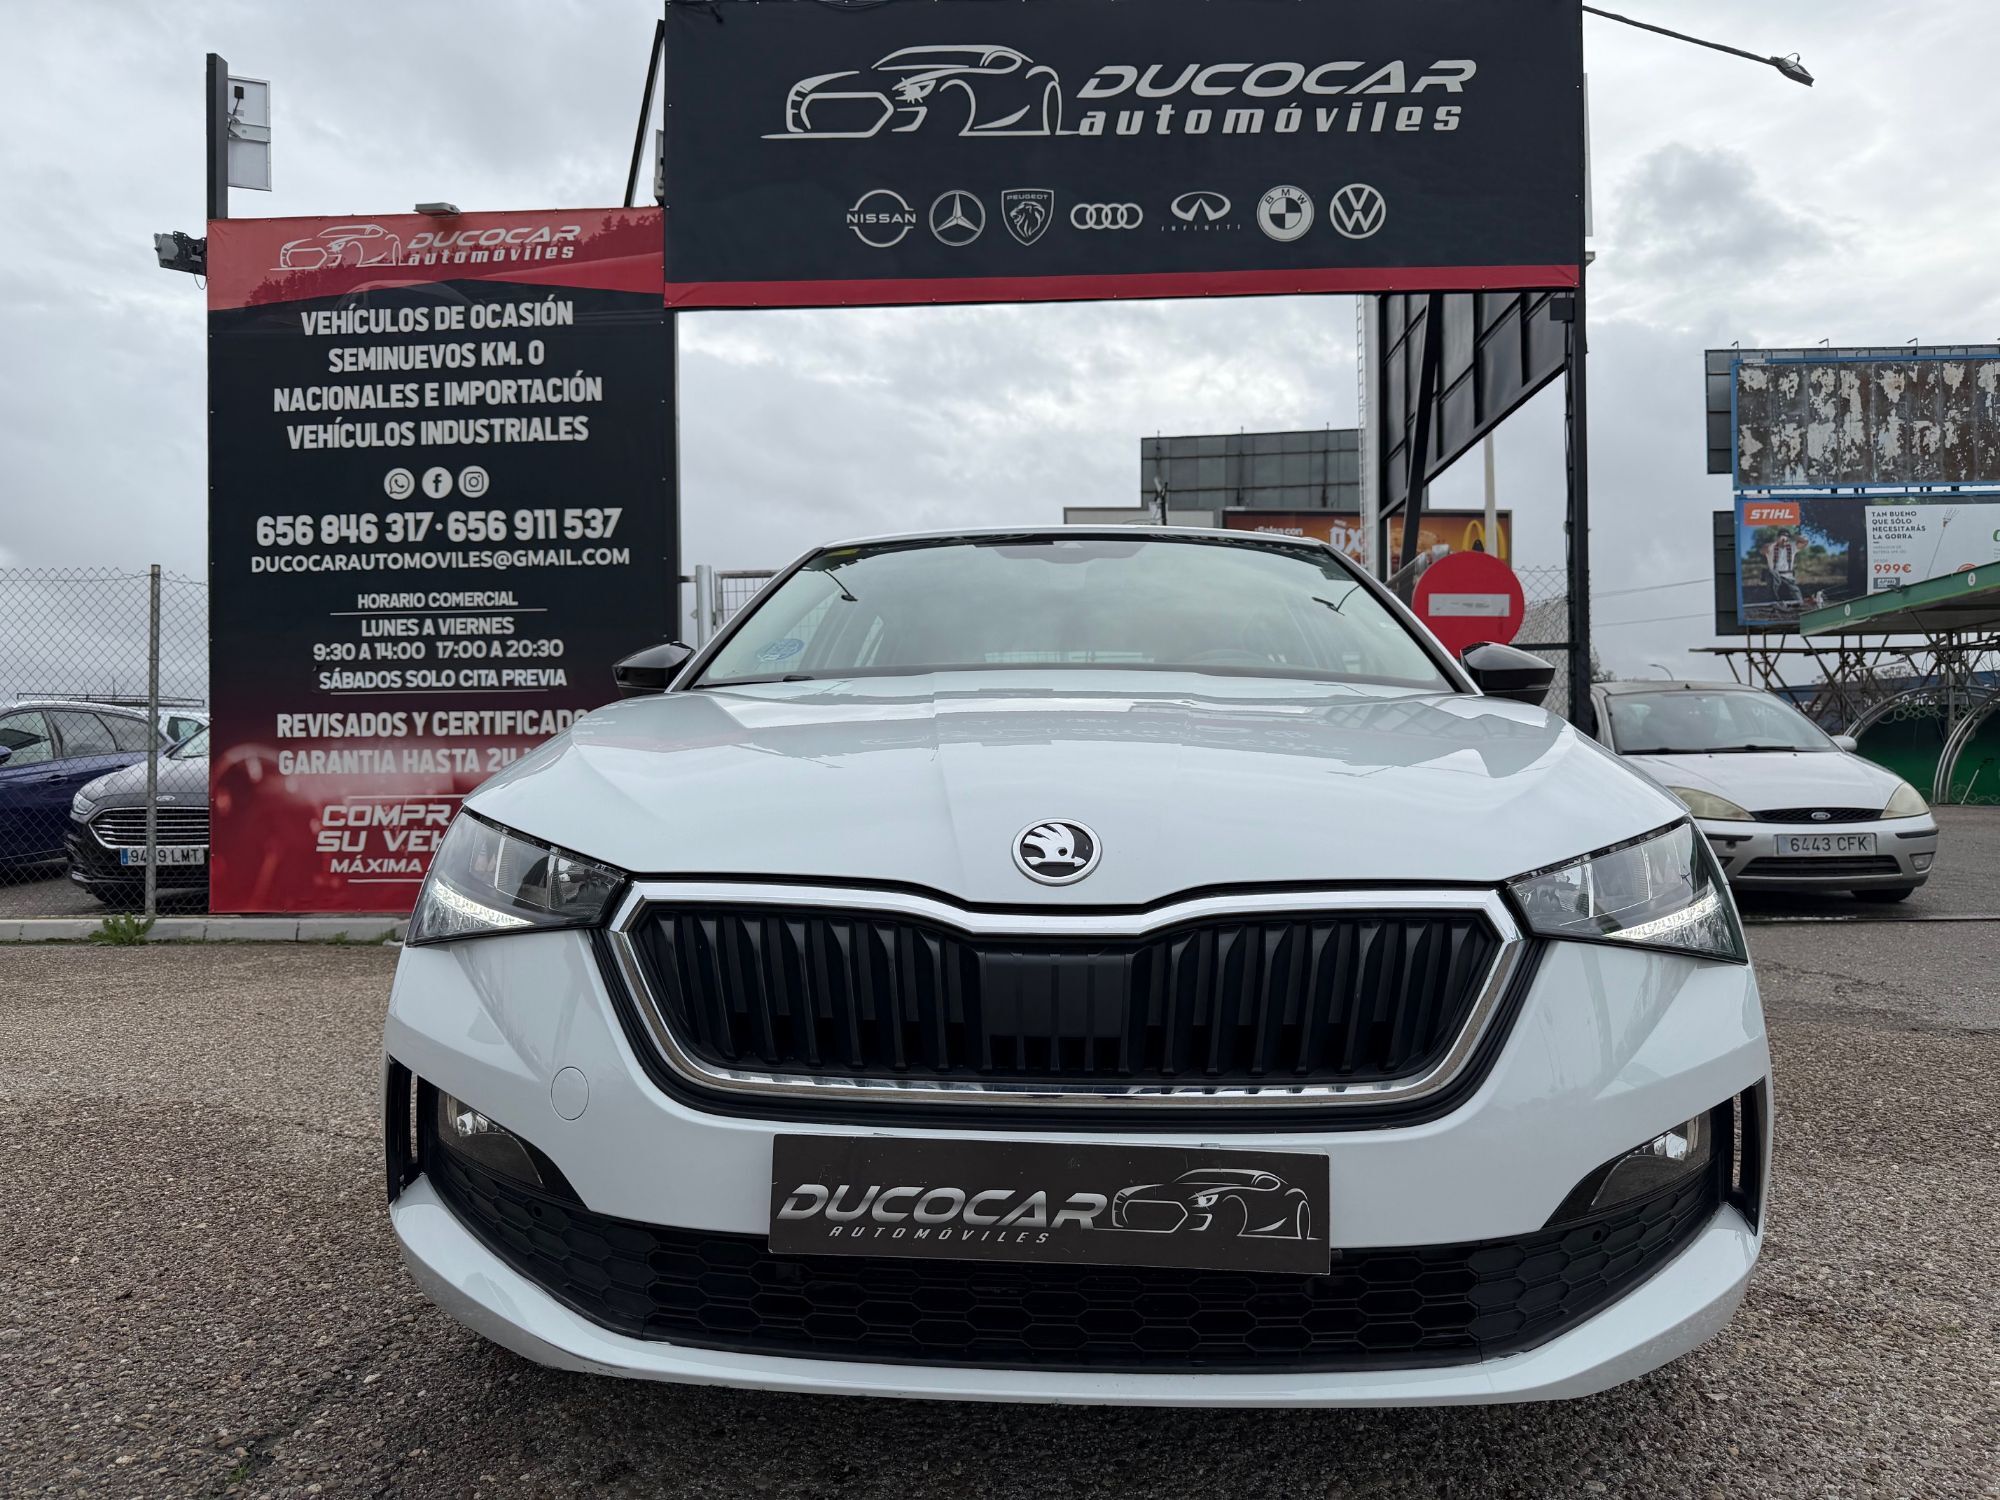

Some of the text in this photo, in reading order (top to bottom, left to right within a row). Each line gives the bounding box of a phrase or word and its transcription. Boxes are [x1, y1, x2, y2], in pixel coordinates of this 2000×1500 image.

[1077, 59, 1477, 98] DUCOCAR
[1079, 101, 1463, 136] automóviles
[1264, 188, 1307, 205] BMW
[846, 213, 917, 224] NISSAN
[1161, 224, 1241, 232] INFINITI
[407, 225, 581, 249] DUCOCAR
[408, 245, 574, 266] automóviles
[301, 294, 574, 336] VEHÍCULOS DE OCASIÓN
[328, 342, 476, 373] SEMINUEVOS
[481, 341, 523, 366] KM.
[273, 370, 603, 413] NACIONALES E IMPORTACIÓN
[287, 416, 589, 449] VEHÍCULOS INDUSTRIALES
[1749, 508, 1794, 519] STIHL
[1890, 517, 1912, 525] SÓLO
[256, 514, 315, 546] 656
[320, 513, 379, 545] 846
[513, 508, 558, 540] 911
[563, 507, 623, 539] 537
[251, 548, 631, 573] DUCOCARAUTOMOVILES@GMAIL.COM
[1874, 563, 1912, 574] 999€
[357, 591, 518, 609] HORARIO COMERCIAL
[361, 617, 515, 637] LUNES A VIERNES
[313, 639, 565, 661] 9:30 A 14:00 17:00 A 20:30
[318, 667, 568, 690] SÁBADOS SOLO CITA PREVIA
[276, 713, 408, 739] REVISADOS
[412, 712, 428, 736] Y
[278, 749, 397, 776] GARANTIA
[401, 748, 479, 774] HASTA
[315, 832, 366, 853] SU
[1791, 836, 1868, 852] 6443 CFK
[130, 849, 199, 863] 949 LMT
[329, 857, 422, 874] MÁXIMA
[777, 1184, 1107, 1230] DUCOCAR
[828, 1226, 1050, 1245] AUTOMÓVILES
